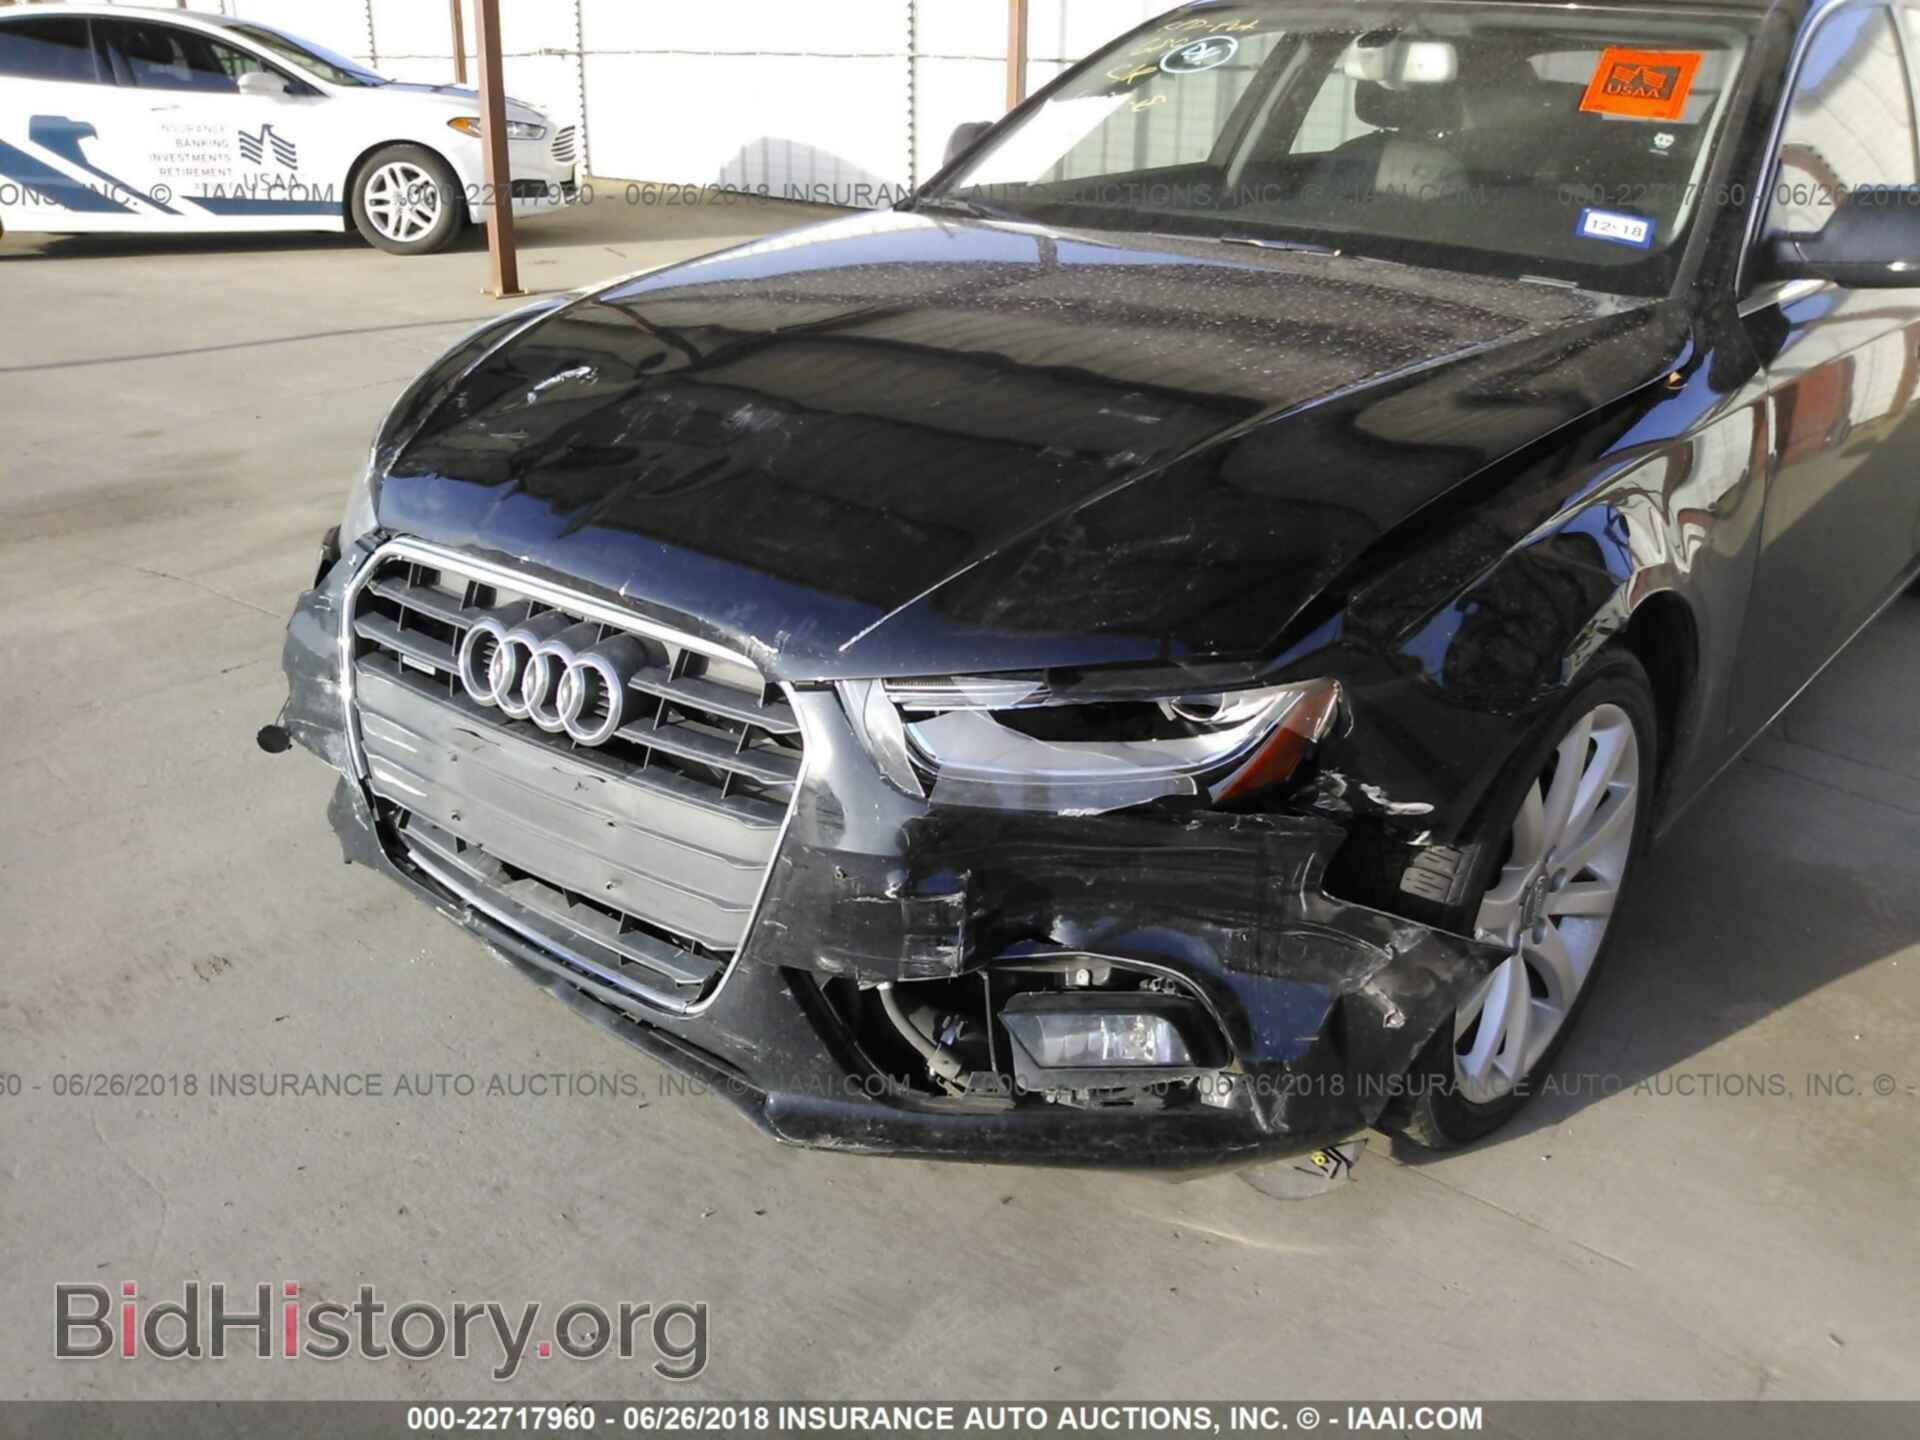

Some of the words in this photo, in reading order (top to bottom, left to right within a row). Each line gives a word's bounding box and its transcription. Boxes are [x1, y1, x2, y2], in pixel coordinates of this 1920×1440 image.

[1607, 83, 1660, 98] USAA
[175, 138, 229, 148] BANKING
[149, 153, 232, 163] INVESTMENTS
[159, 167, 232, 177] RETIREMENT
[243, 173, 298, 191] USAA
